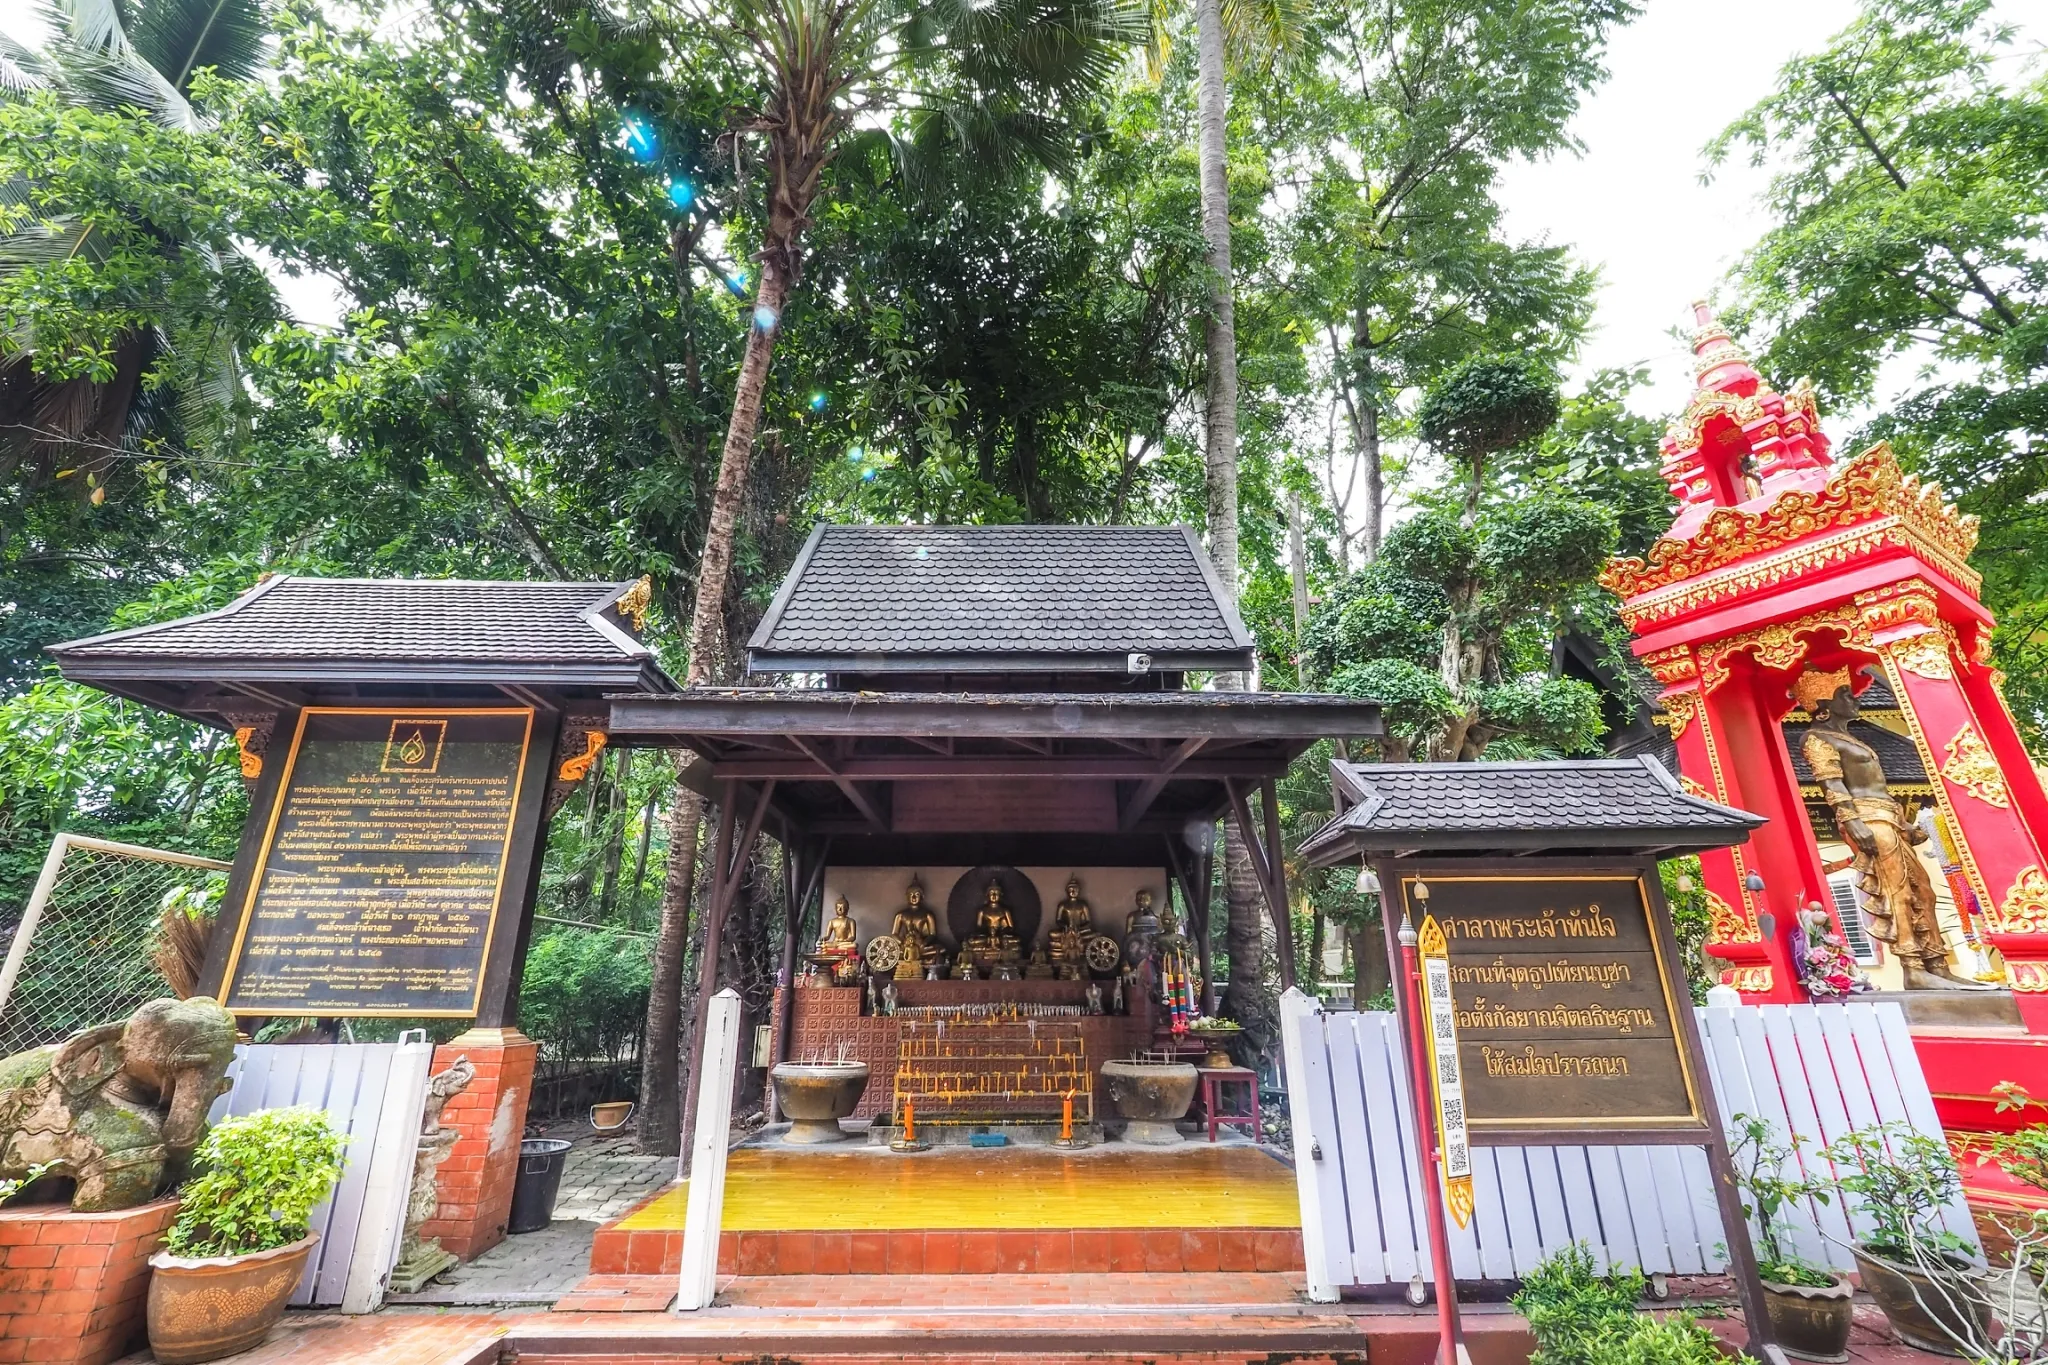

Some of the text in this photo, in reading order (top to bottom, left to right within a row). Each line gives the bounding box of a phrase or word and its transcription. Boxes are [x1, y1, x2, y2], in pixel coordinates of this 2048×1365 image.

[1441, 904, 1617, 939] ศาลาพระเจ้าทันใจ
[1449, 954, 1631, 991] สถานที่จุดธูปเทียนบูชา
[1453, 996, 1656, 1034] ื่อตั้งกัลยาณจิตอธิษฐาน
[1481, 1045, 1629, 1077] ให้สมใจปรารถนา
